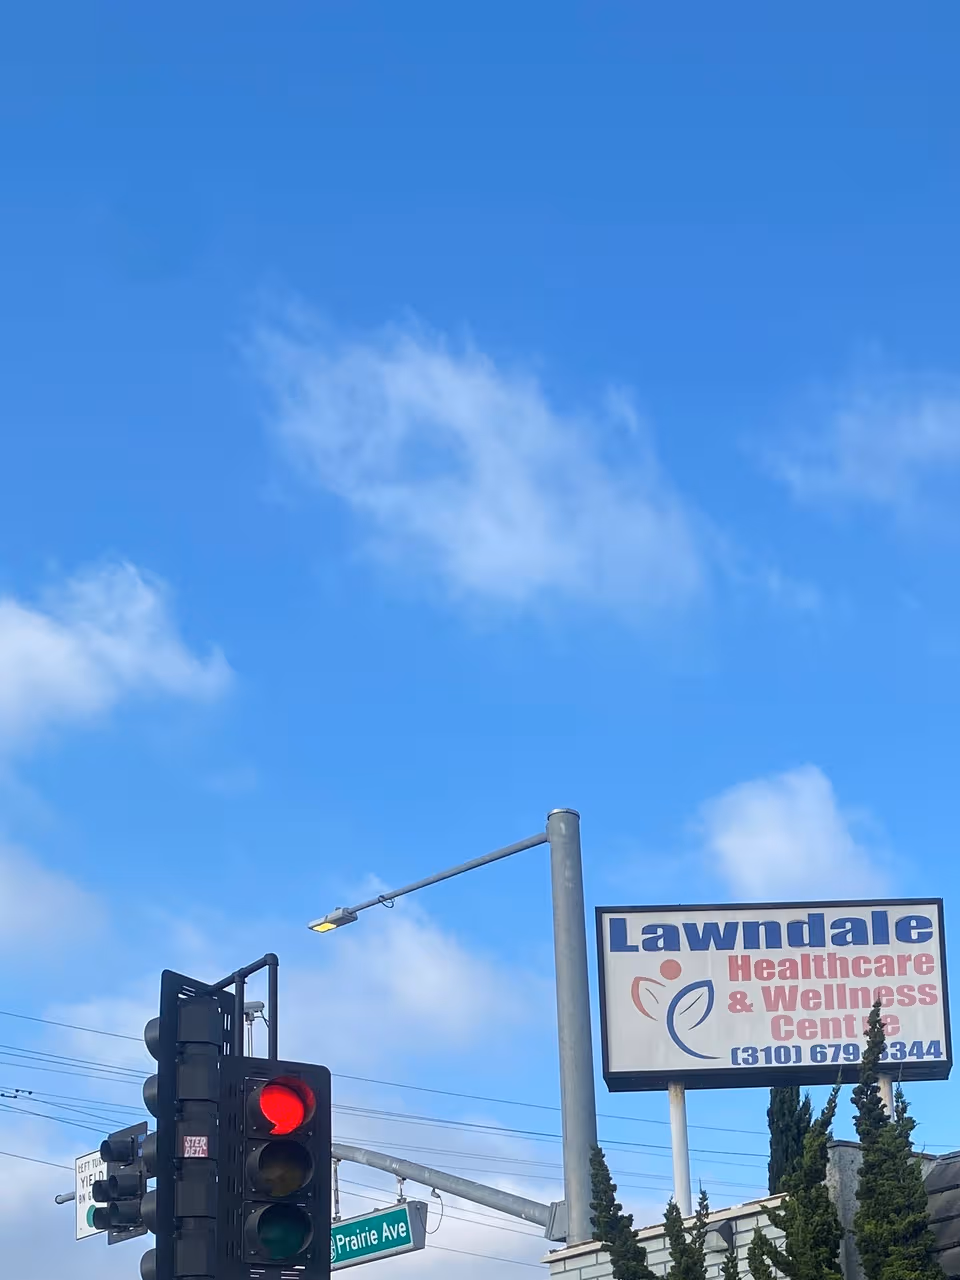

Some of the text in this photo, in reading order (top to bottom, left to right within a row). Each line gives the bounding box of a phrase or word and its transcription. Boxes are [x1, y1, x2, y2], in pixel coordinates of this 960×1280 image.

[609, 910, 934, 952] Lawndale
[728, 952, 935, 982] Healthcare
[727, 983, 938, 1014] & Wellness
[731, 1044, 802, 1067] (310)
[78, 1157, 105, 1174] LEFT TUR
[336, 1221, 407, 1254] Prairie Ave
